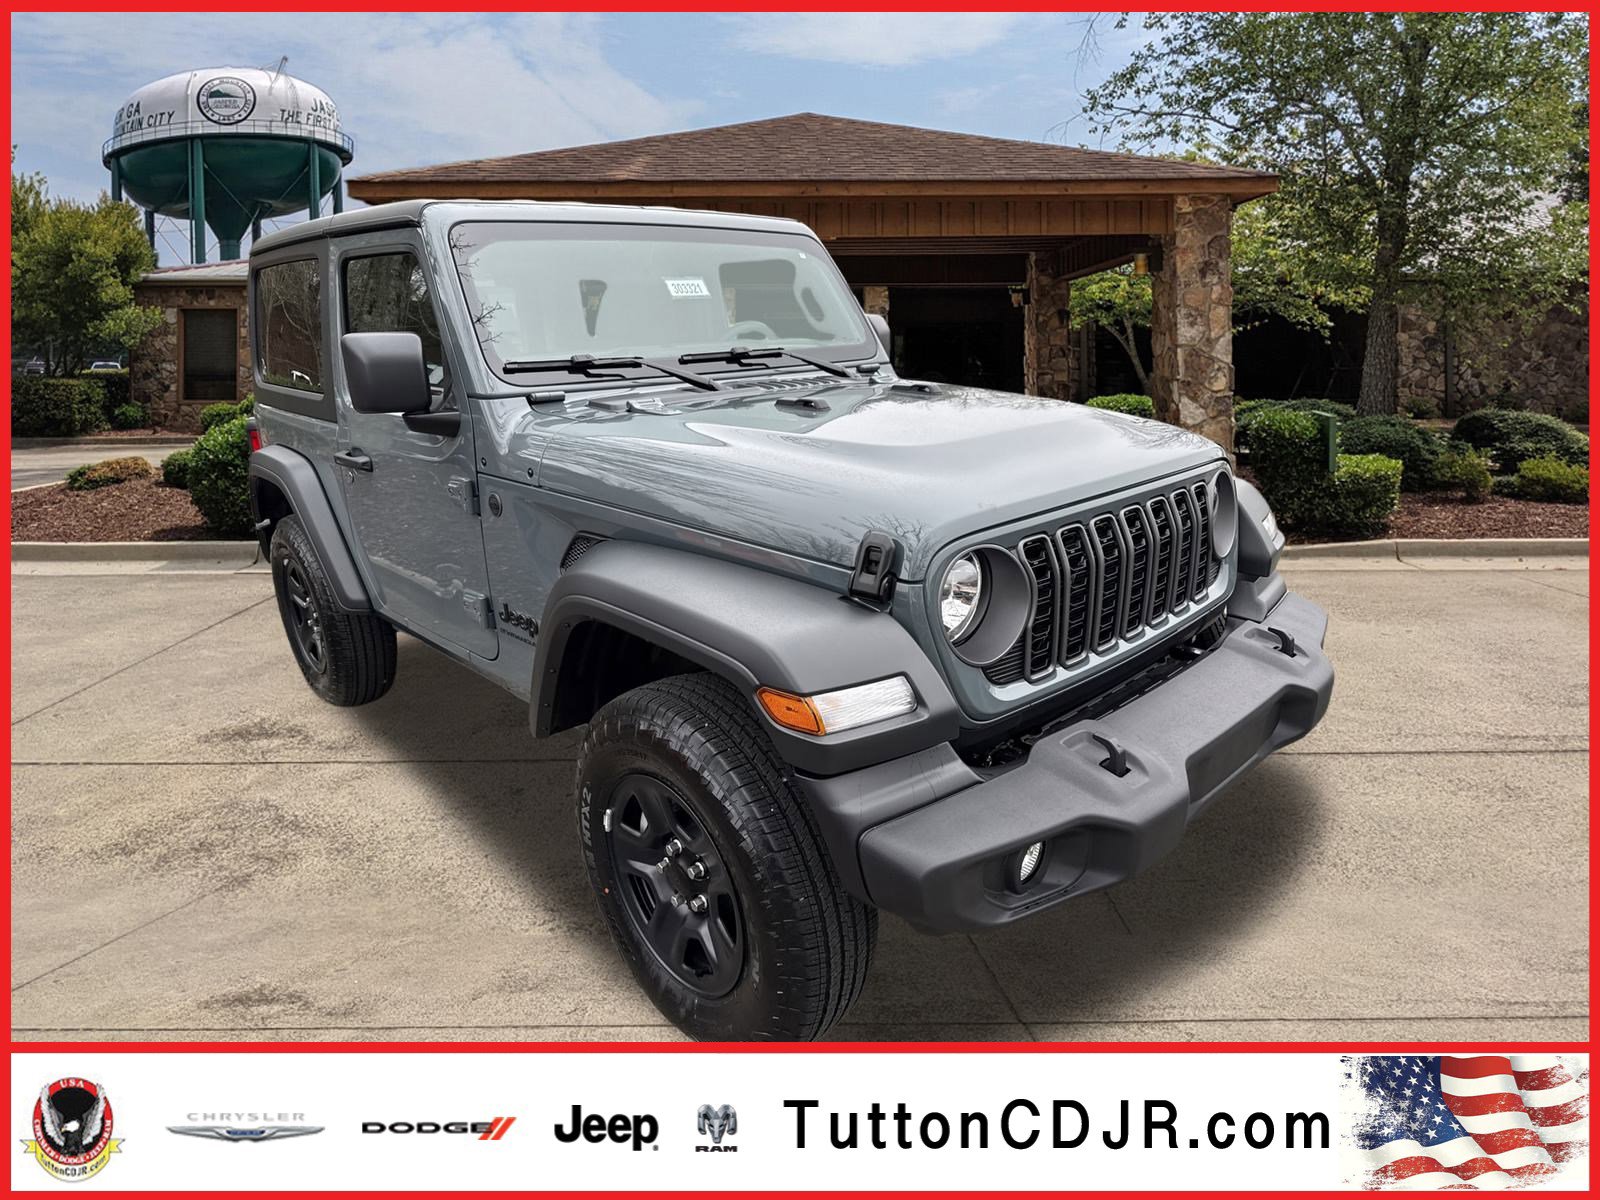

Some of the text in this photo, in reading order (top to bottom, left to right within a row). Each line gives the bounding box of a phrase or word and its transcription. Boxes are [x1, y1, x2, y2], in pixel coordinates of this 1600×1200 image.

[127, 101, 141, 119] GA
[280, 109, 302, 123] THE
[147, 111, 175, 127] CITY
[671, 283, 703, 294] 303321
[499, 603, 539, 638] Jeep
